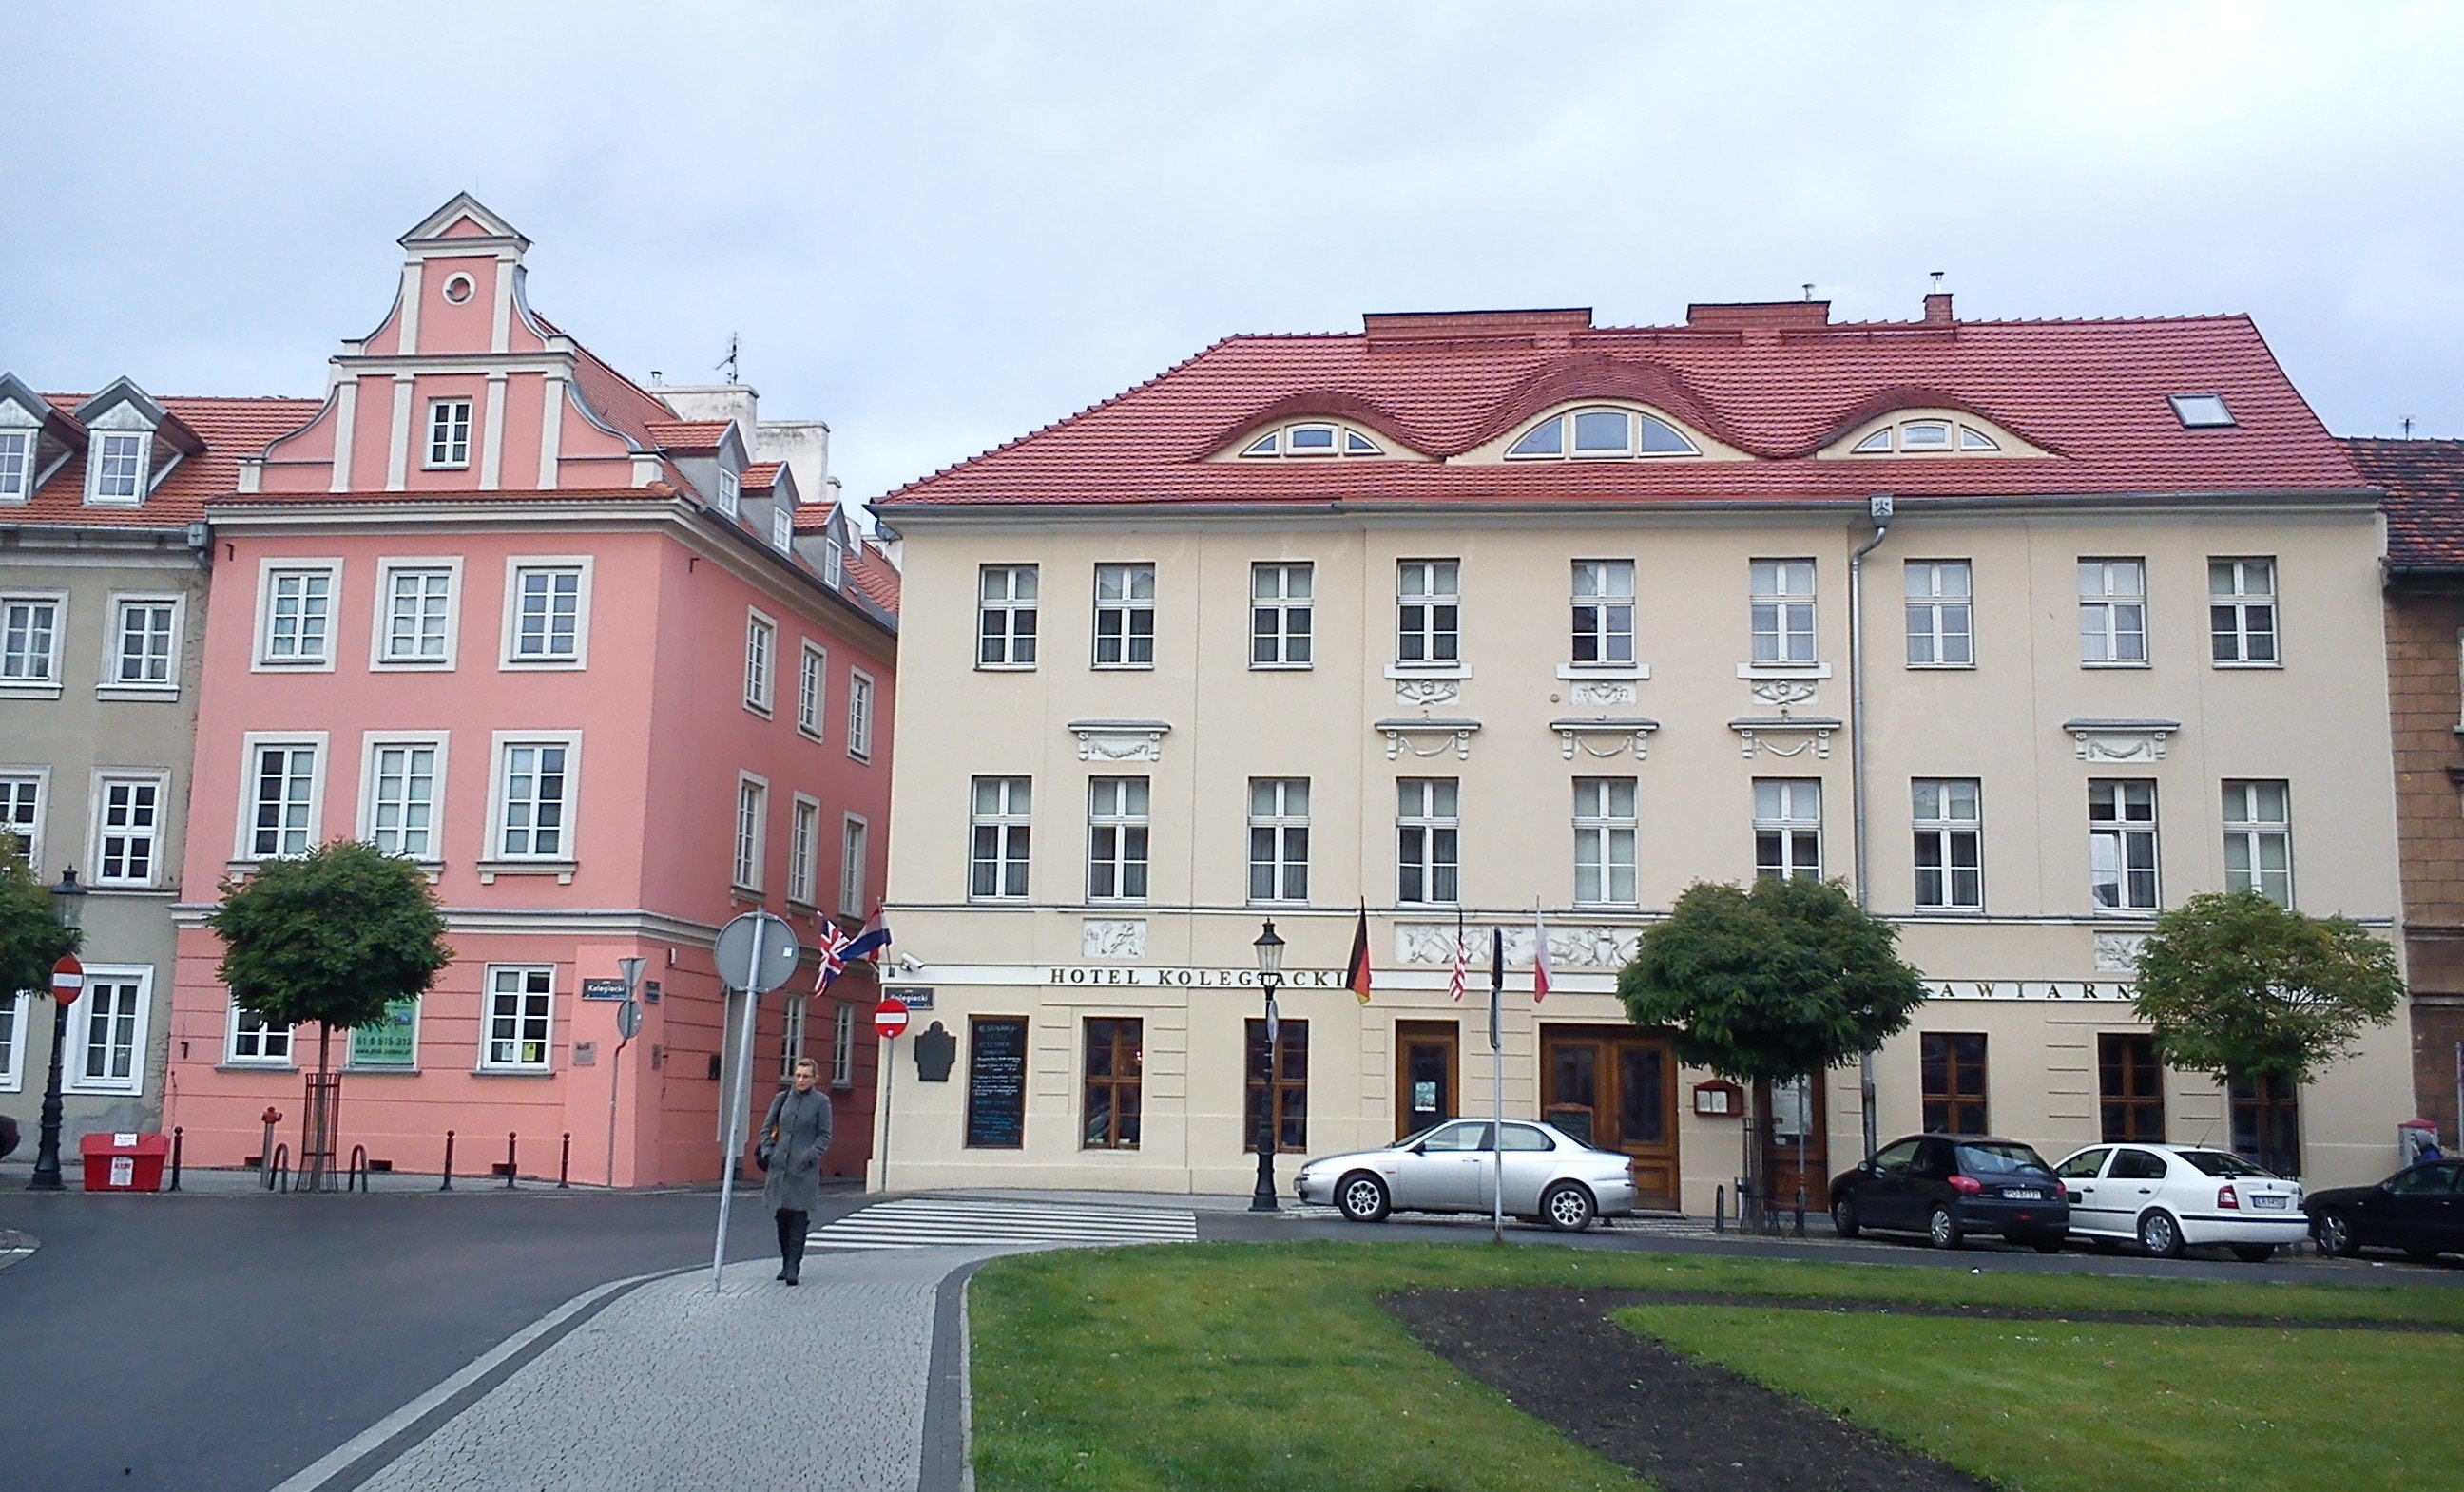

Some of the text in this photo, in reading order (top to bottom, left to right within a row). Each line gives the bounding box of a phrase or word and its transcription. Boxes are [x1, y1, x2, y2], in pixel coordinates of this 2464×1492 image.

[1050, 969, 1343, 986] HOTEL KOLEGIACKI
[587, 985, 625, 994] Kolegiacki
[1939, 983, 2131, 999] AWIARN
